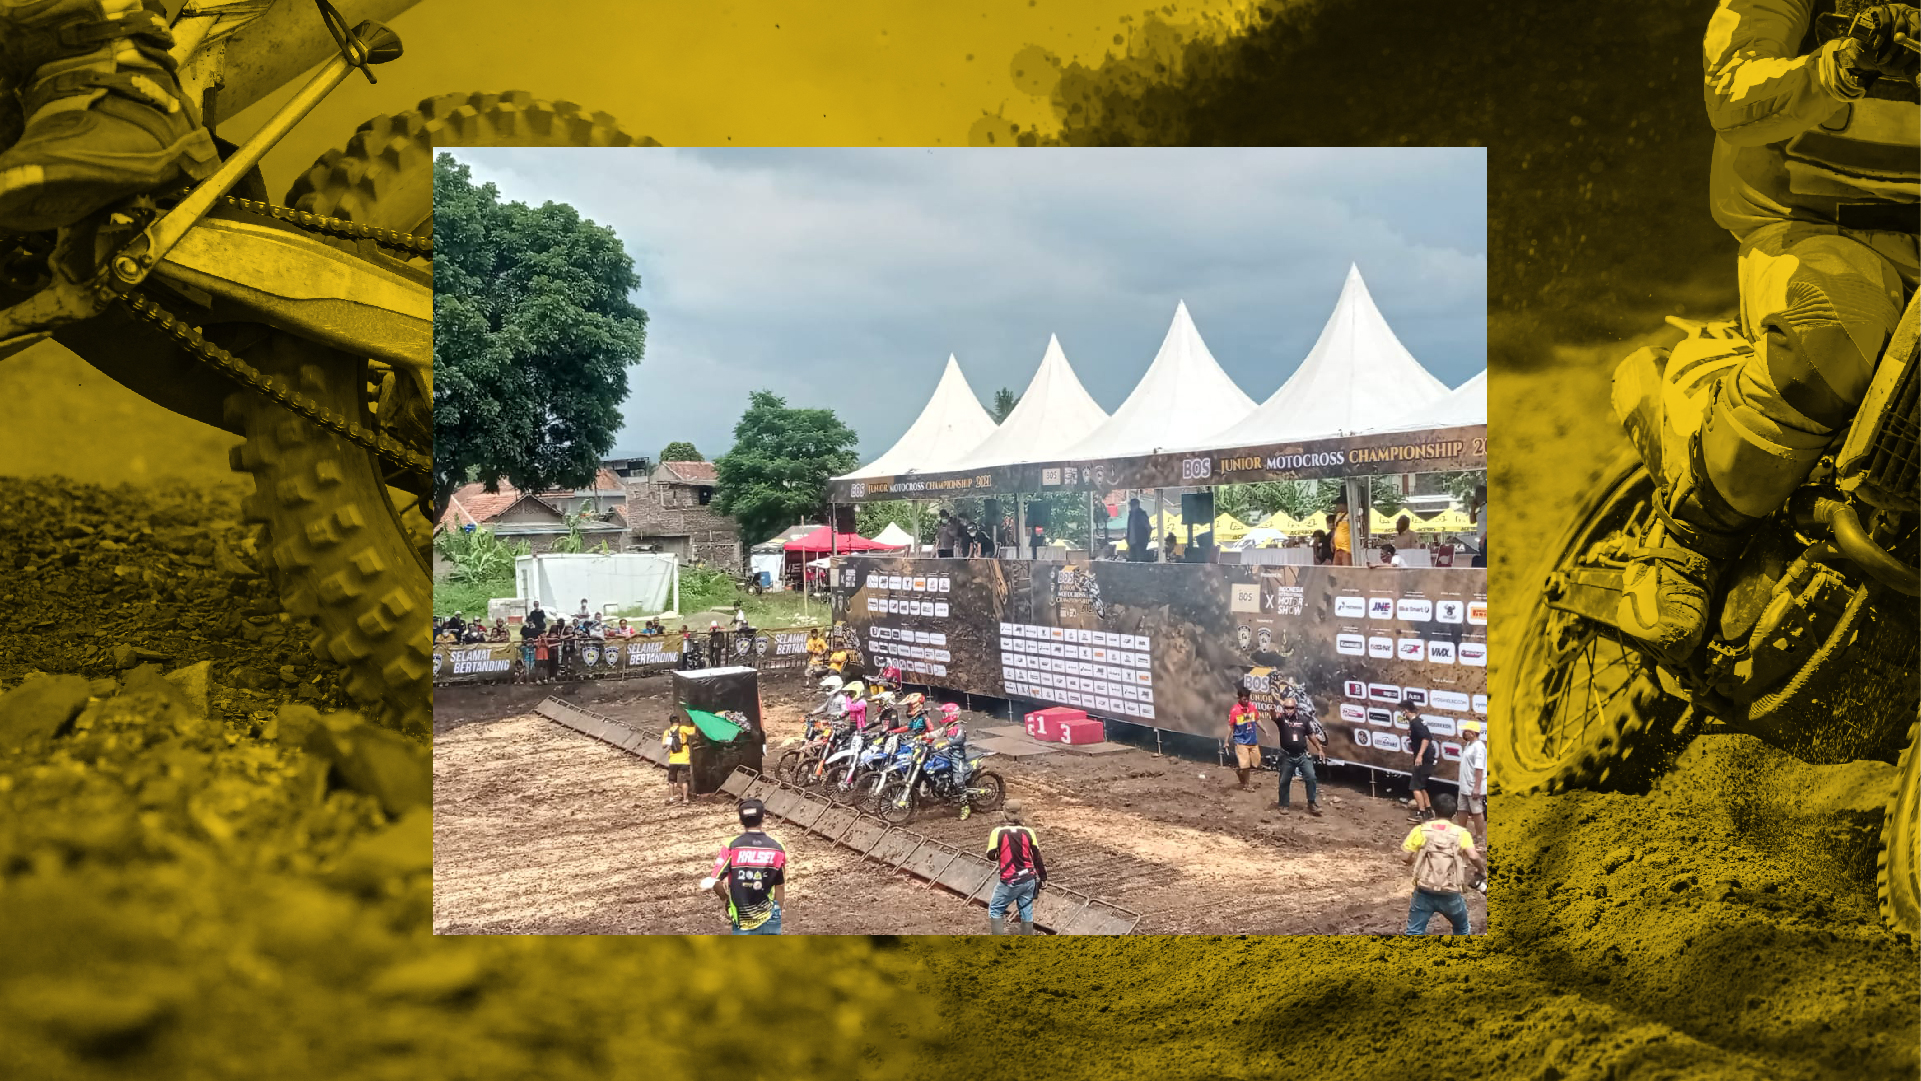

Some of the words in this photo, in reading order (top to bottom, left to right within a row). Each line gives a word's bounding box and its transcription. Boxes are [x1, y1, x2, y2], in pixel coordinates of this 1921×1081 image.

[1182, 457, 1211, 480] BOS
[1220, 456, 1262, 474] JUNIOR
[1265, 451, 1345, 470] MOTOCROSS
[1348, 442, 1463, 464] CHAMPIONSHIP
[850, 483, 865, 498] BOS
[868, 483, 889, 494] JUNIOR
[889, 481, 926, 494] MOTOCROSS
[925, 479, 973, 492] CHAMPIONSHIP
[1238, 592, 1253, 602] BOS
[1265, 594, 1275, 609] X
[1277, 597, 1303, 607] MOTOR
[1372, 602, 1391, 612] JNE
[1277, 605, 1303, 617] SHOW
[775, 633, 809, 645] SELAMAT
[627, 641, 665, 655] SELAMAT
[776, 643, 808, 655] BERTAN
[1431, 647, 1450, 658] VMX
[450, 649, 492, 663] SELAMAT
[629, 651, 679, 666] BERTANDING
[453, 659, 510, 674] BERTANDING
[1243, 673, 1271, 693] BOS
[1037, 716, 1047, 735] 1
[1060, 723, 1071, 744] 3
